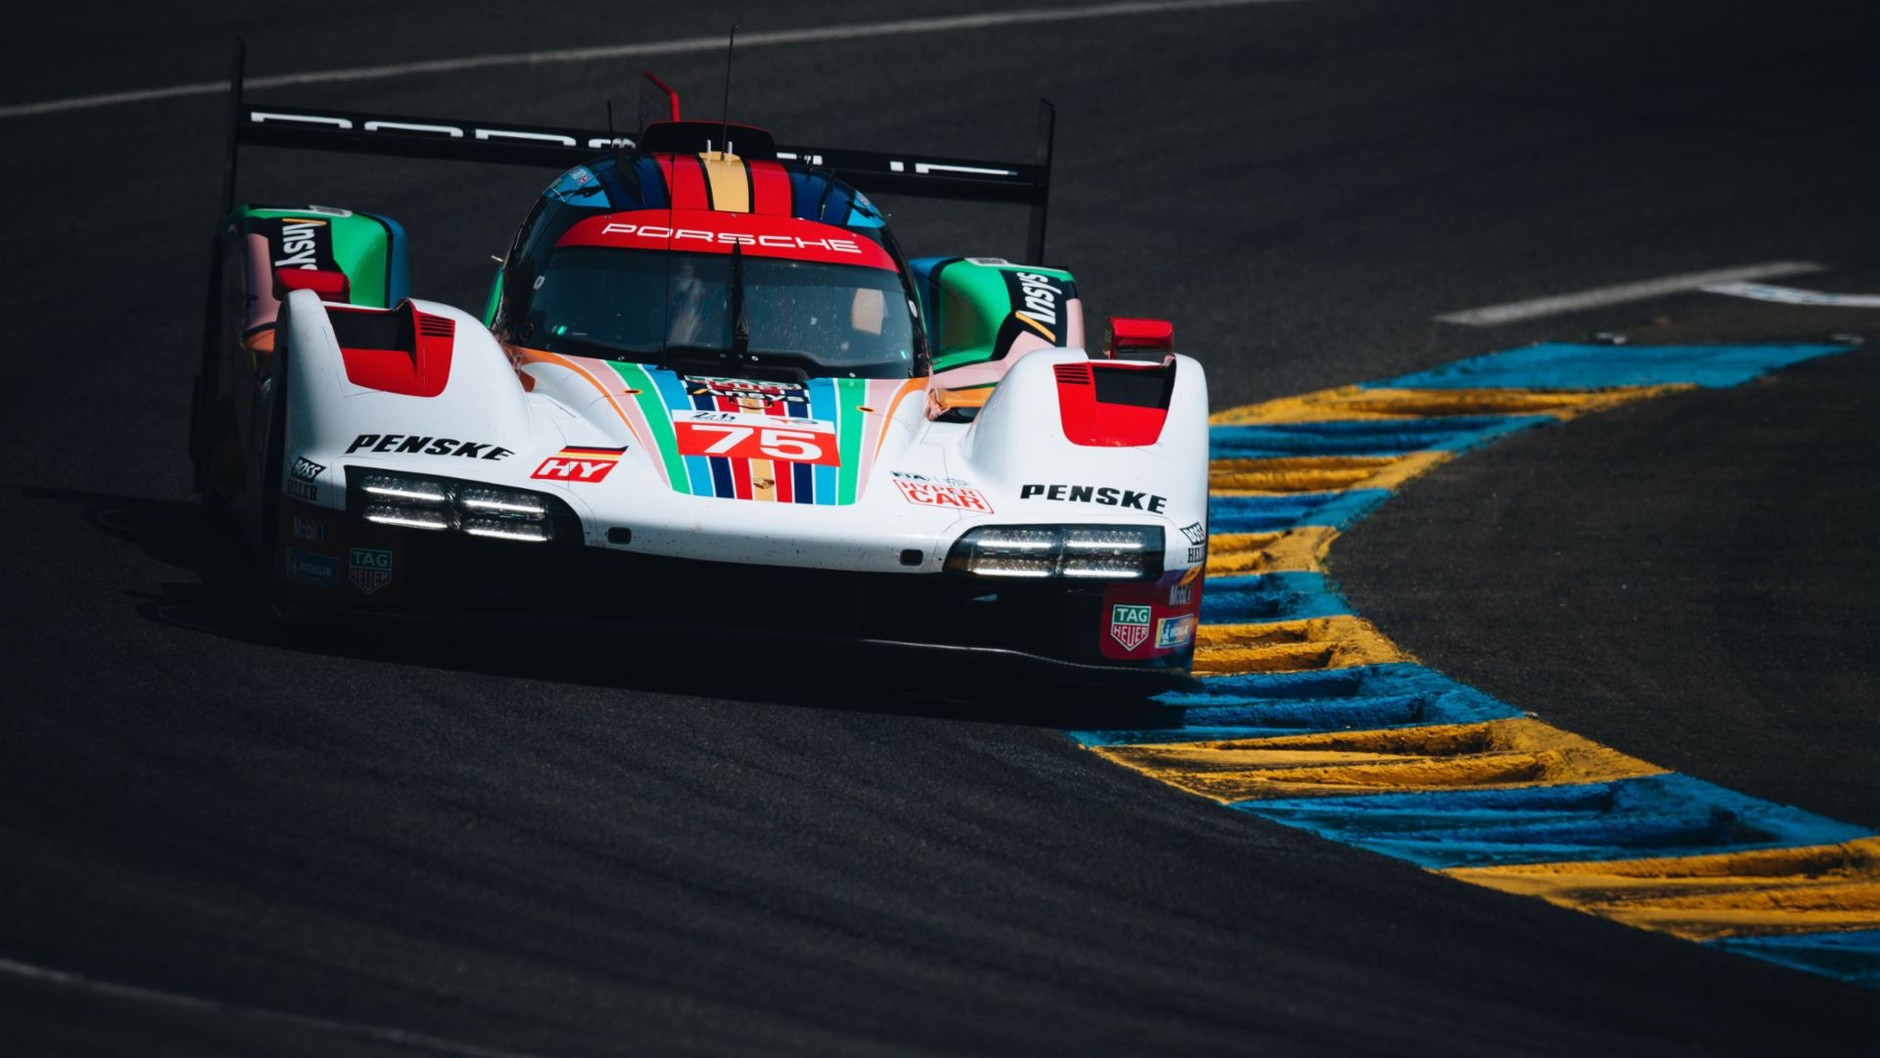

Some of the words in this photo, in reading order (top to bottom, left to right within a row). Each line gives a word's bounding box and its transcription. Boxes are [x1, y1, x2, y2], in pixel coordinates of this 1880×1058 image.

[602, 223, 862, 254] PORSCHE
[1015, 272, 1062, 343] Ansys
[345, 434, 515, 461] PENSKE
[691, 424, 823, 460] 75
[541, 459, 609, 479] HY
[901, 481, 976, 497] HYPER
[908, 489, 985, 510] CAR
[1020, 484, 1167, 514] PENSKE
[352, 550, 389, 568] TAG
[350, 569, 389, 591] HEUER
[1116, 607, 1148, 623] TAG
[1113, 625, 1148, 647] HEUER
